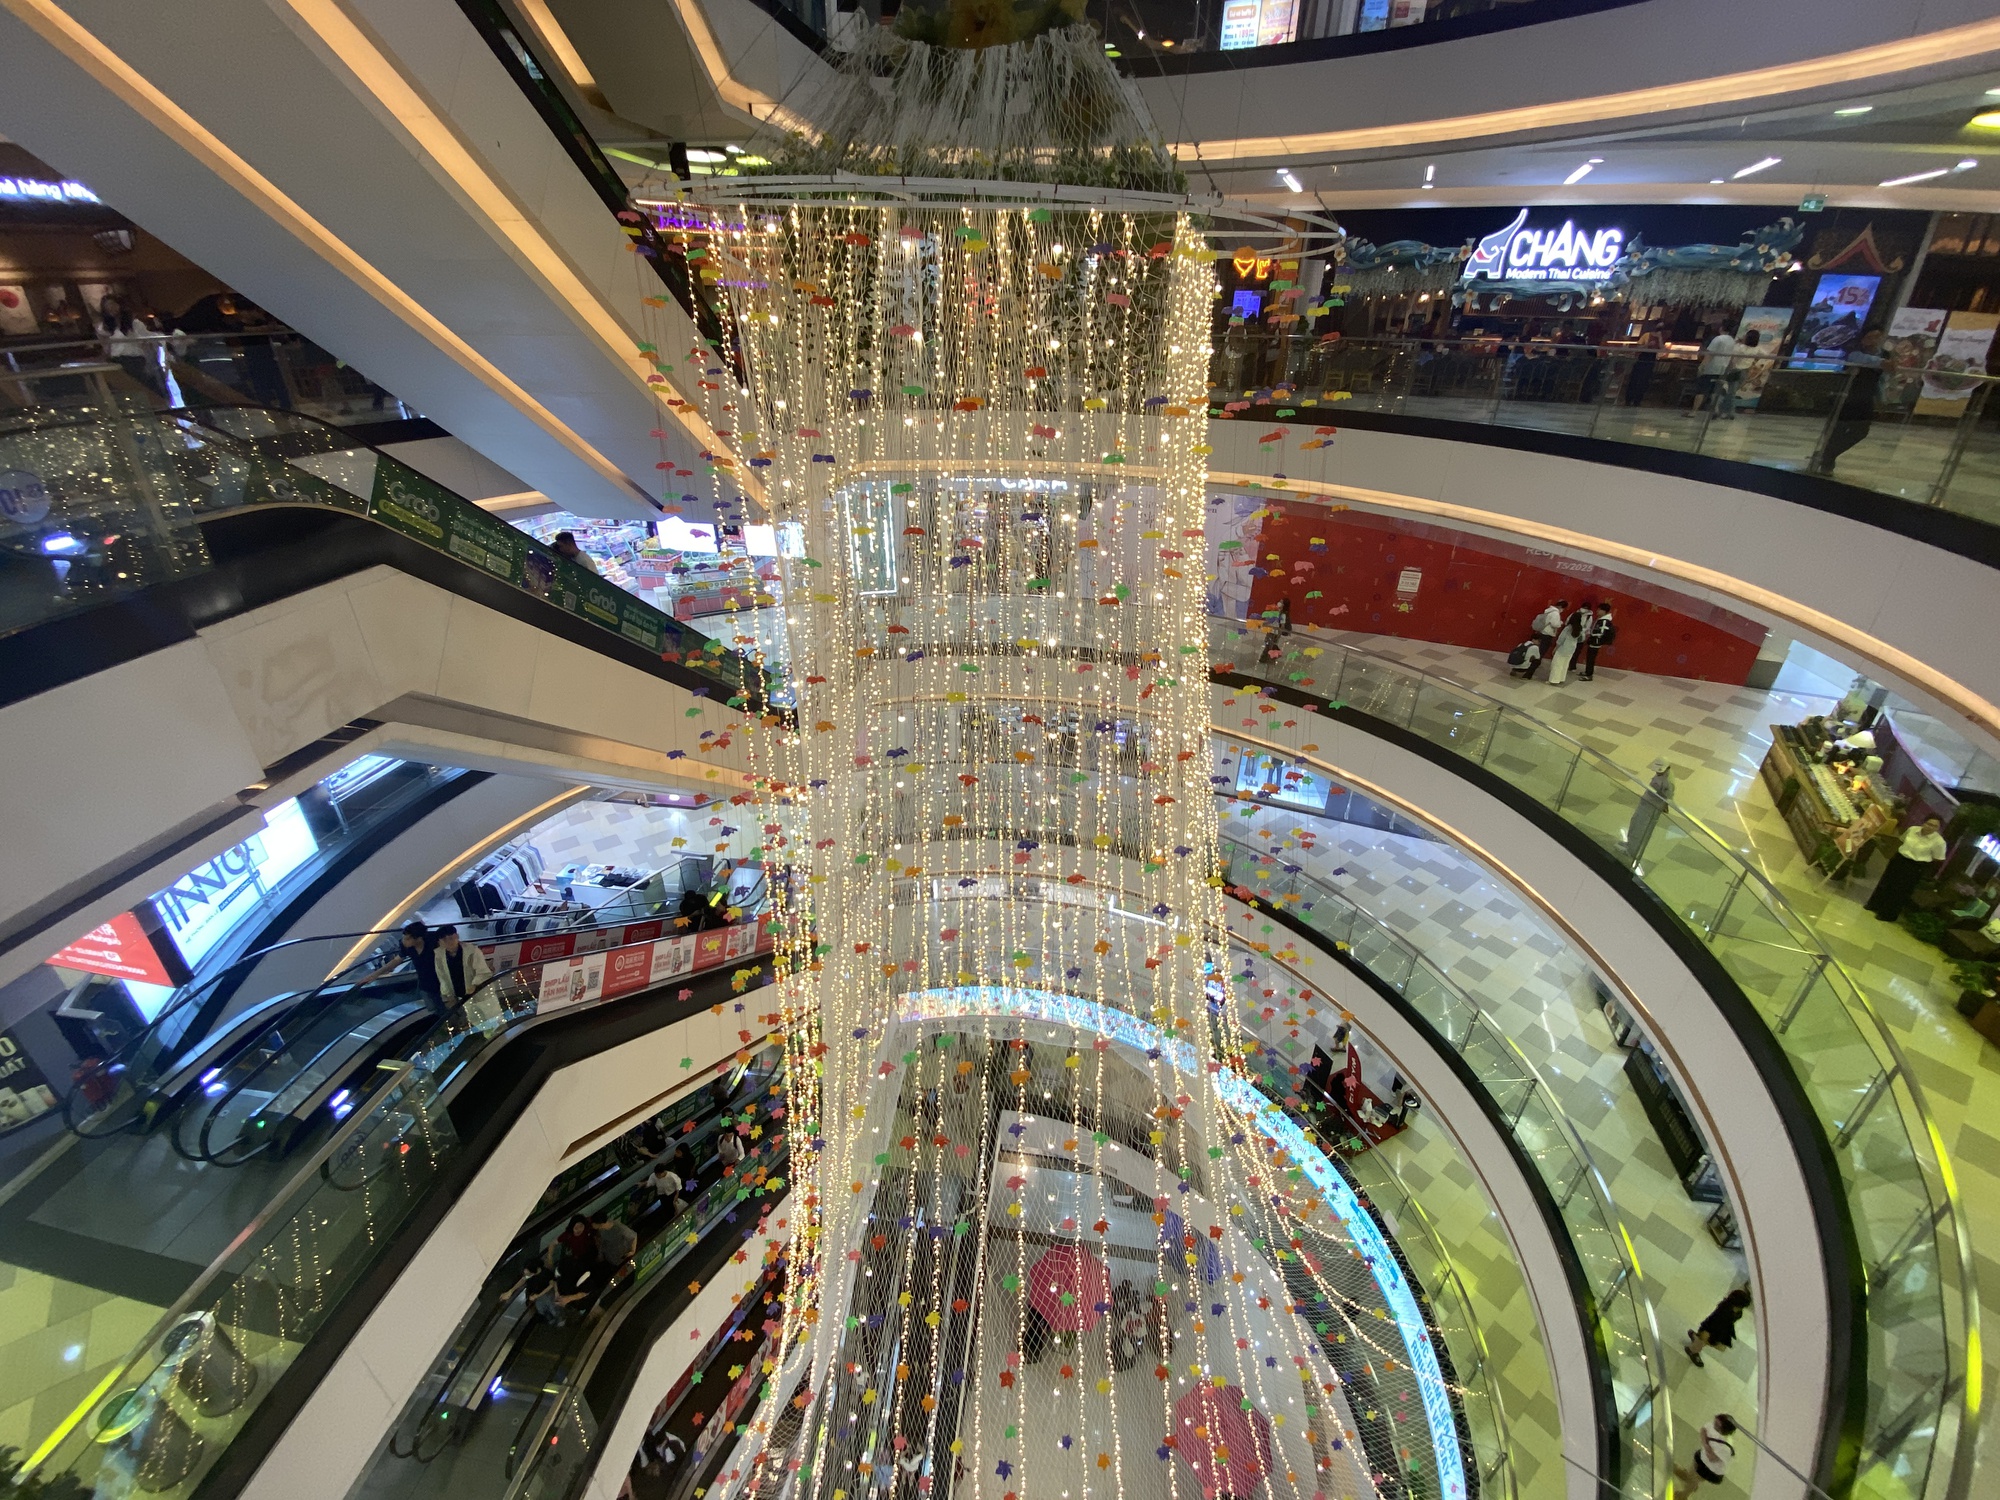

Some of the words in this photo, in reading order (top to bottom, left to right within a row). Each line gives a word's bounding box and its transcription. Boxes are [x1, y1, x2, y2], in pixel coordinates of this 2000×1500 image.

[1509, 219, 1622, 267] CHANG
[1506, 268, 1547, 279] Modern
[1549, 267, 1571, 279] Thai
[1571, 267, 1611, 279] Cuisine
[390, 481, 440, 522] Grab
[589, 587, 617, 614] Grab
